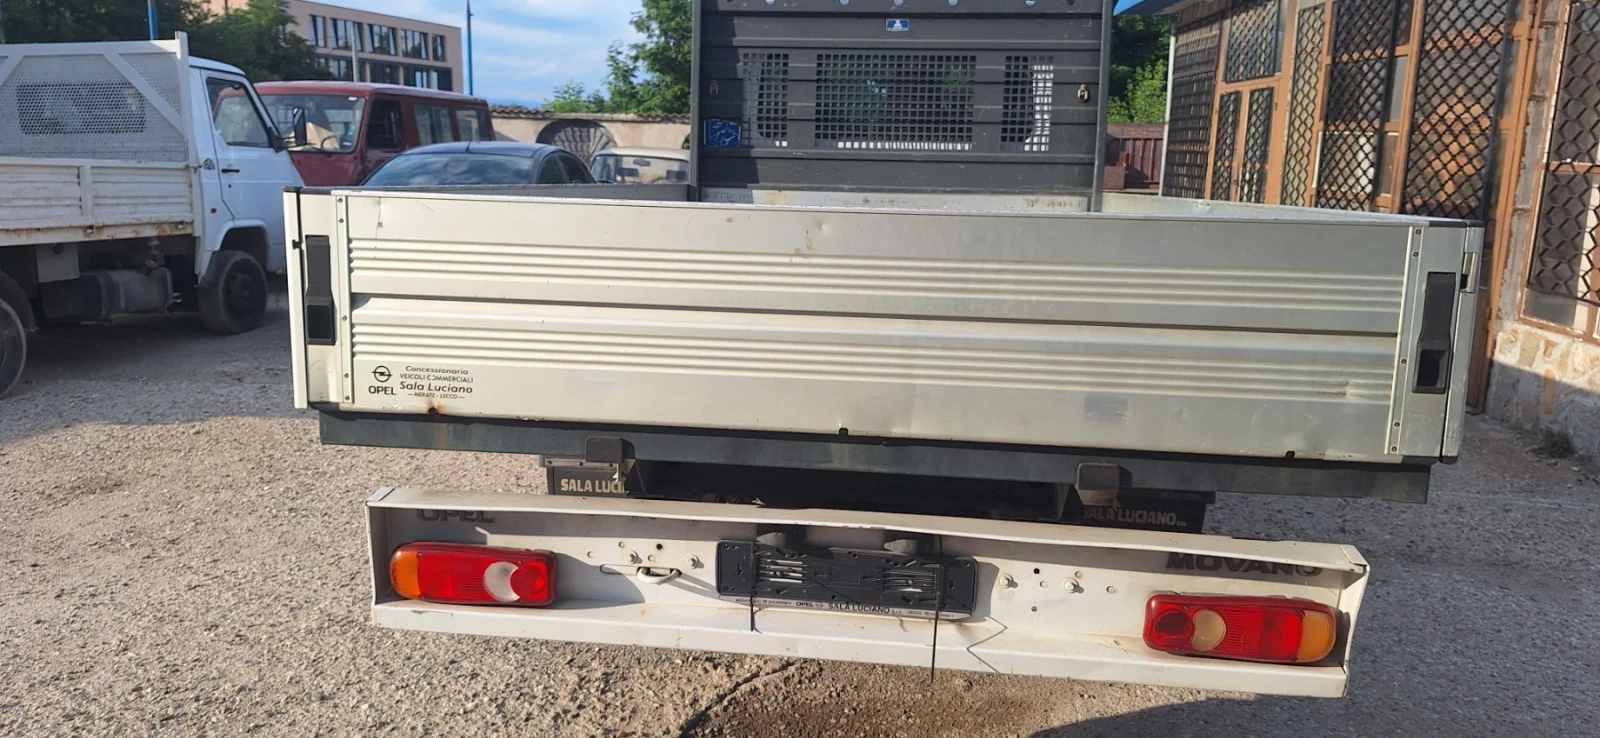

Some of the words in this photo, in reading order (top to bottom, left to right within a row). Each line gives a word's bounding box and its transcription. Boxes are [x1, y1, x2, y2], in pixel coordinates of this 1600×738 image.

[405, 365, 469, 375] Concessionaria
[399, 372, 426, 381] VEICOLI
[368, 385, 398, 396] OPEL
[399, 381, 425, 391] Sala
[427, 382, 473, 394] Luciano
[560, 478, 593, 492] SALA
[416, 508, 495, 524] OPEL
[1117, 508, 1177, 526] LUCIANO
[828, 602, 851, 611] SALA
[852, 604, 891, 614] LUCIANO
